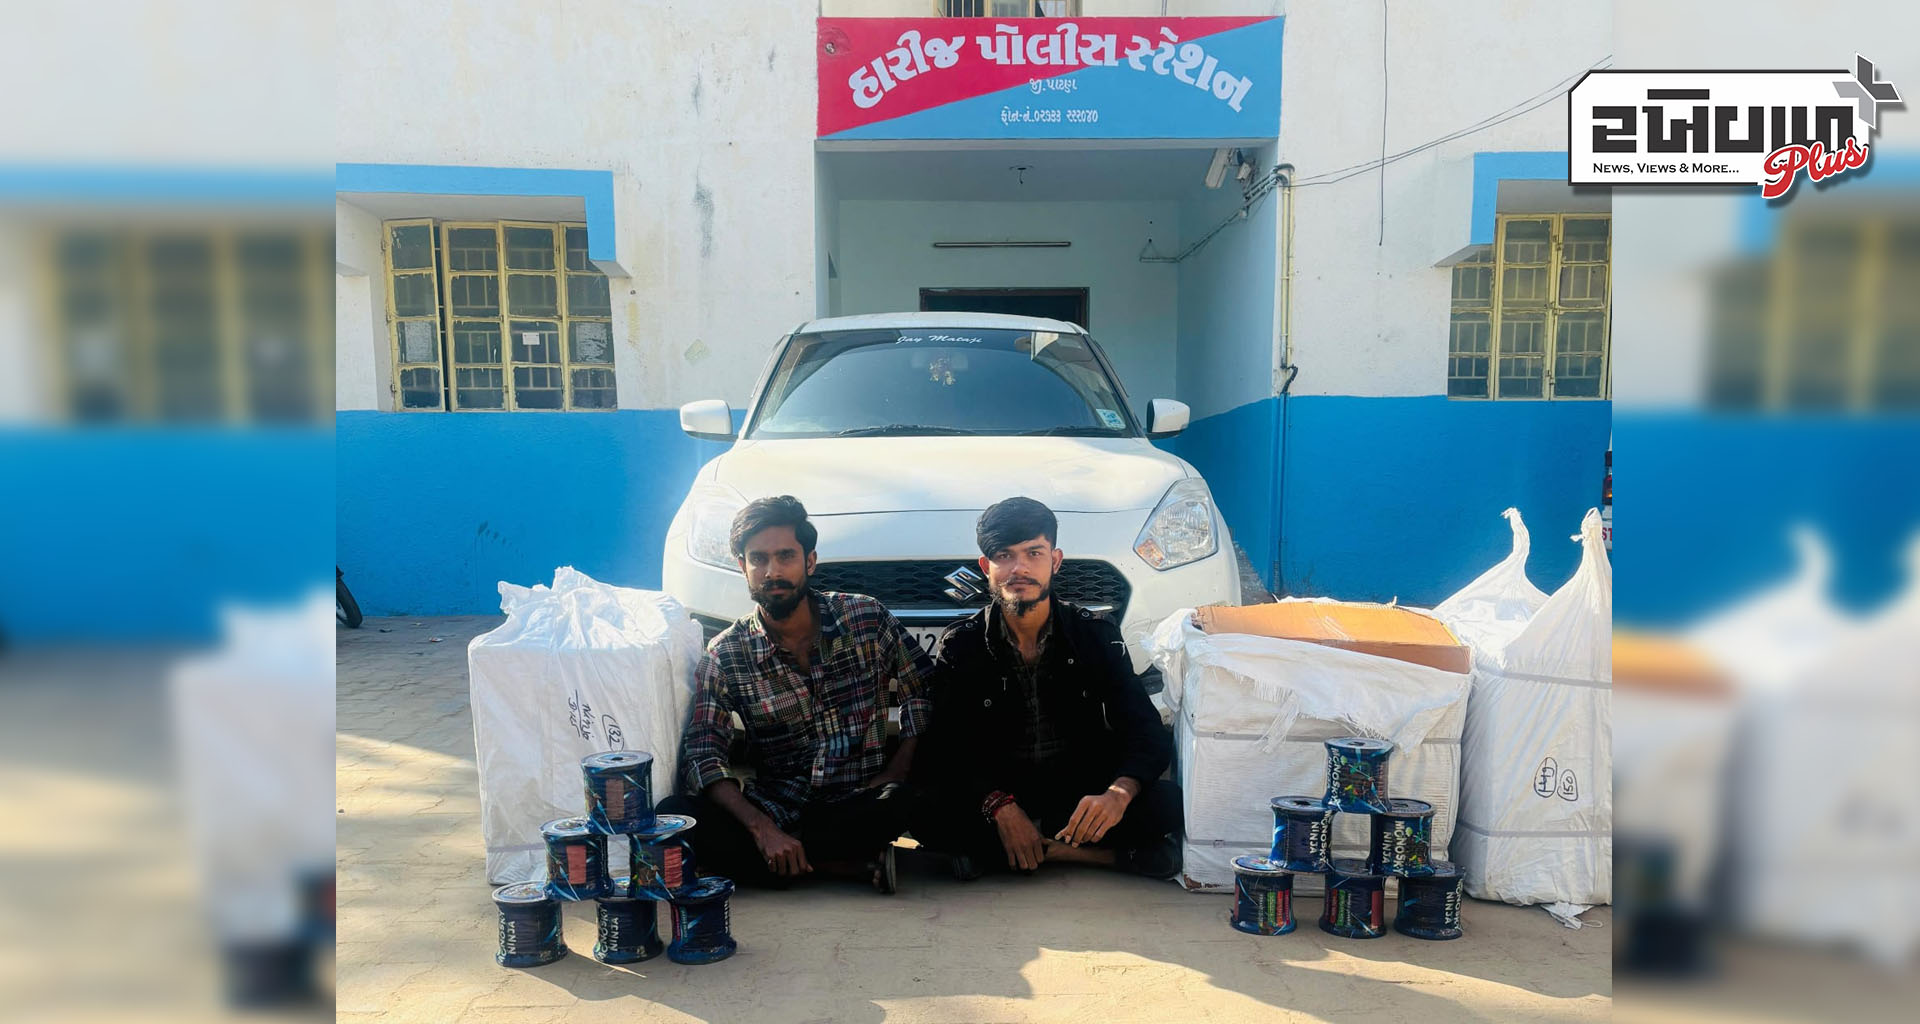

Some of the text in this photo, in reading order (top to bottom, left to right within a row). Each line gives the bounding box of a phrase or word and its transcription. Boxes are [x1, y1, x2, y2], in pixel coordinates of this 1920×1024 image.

[848, 22, 1254, 113] હારીજ પોલીસ સ્ટેશન
[895, 335, 923, 345] Jay
[608, 724, 622, 747] 132
[1563, 775, 1574, 795] 150
[1309, 821, 1319, 854] NINJA
[1382, 831, 1392, 864] NINJA
[1444, 891, 1455, 925] NINJA
[507, 920, 516, 955] NINJA
[610, 917, 619, 952] NINJA
